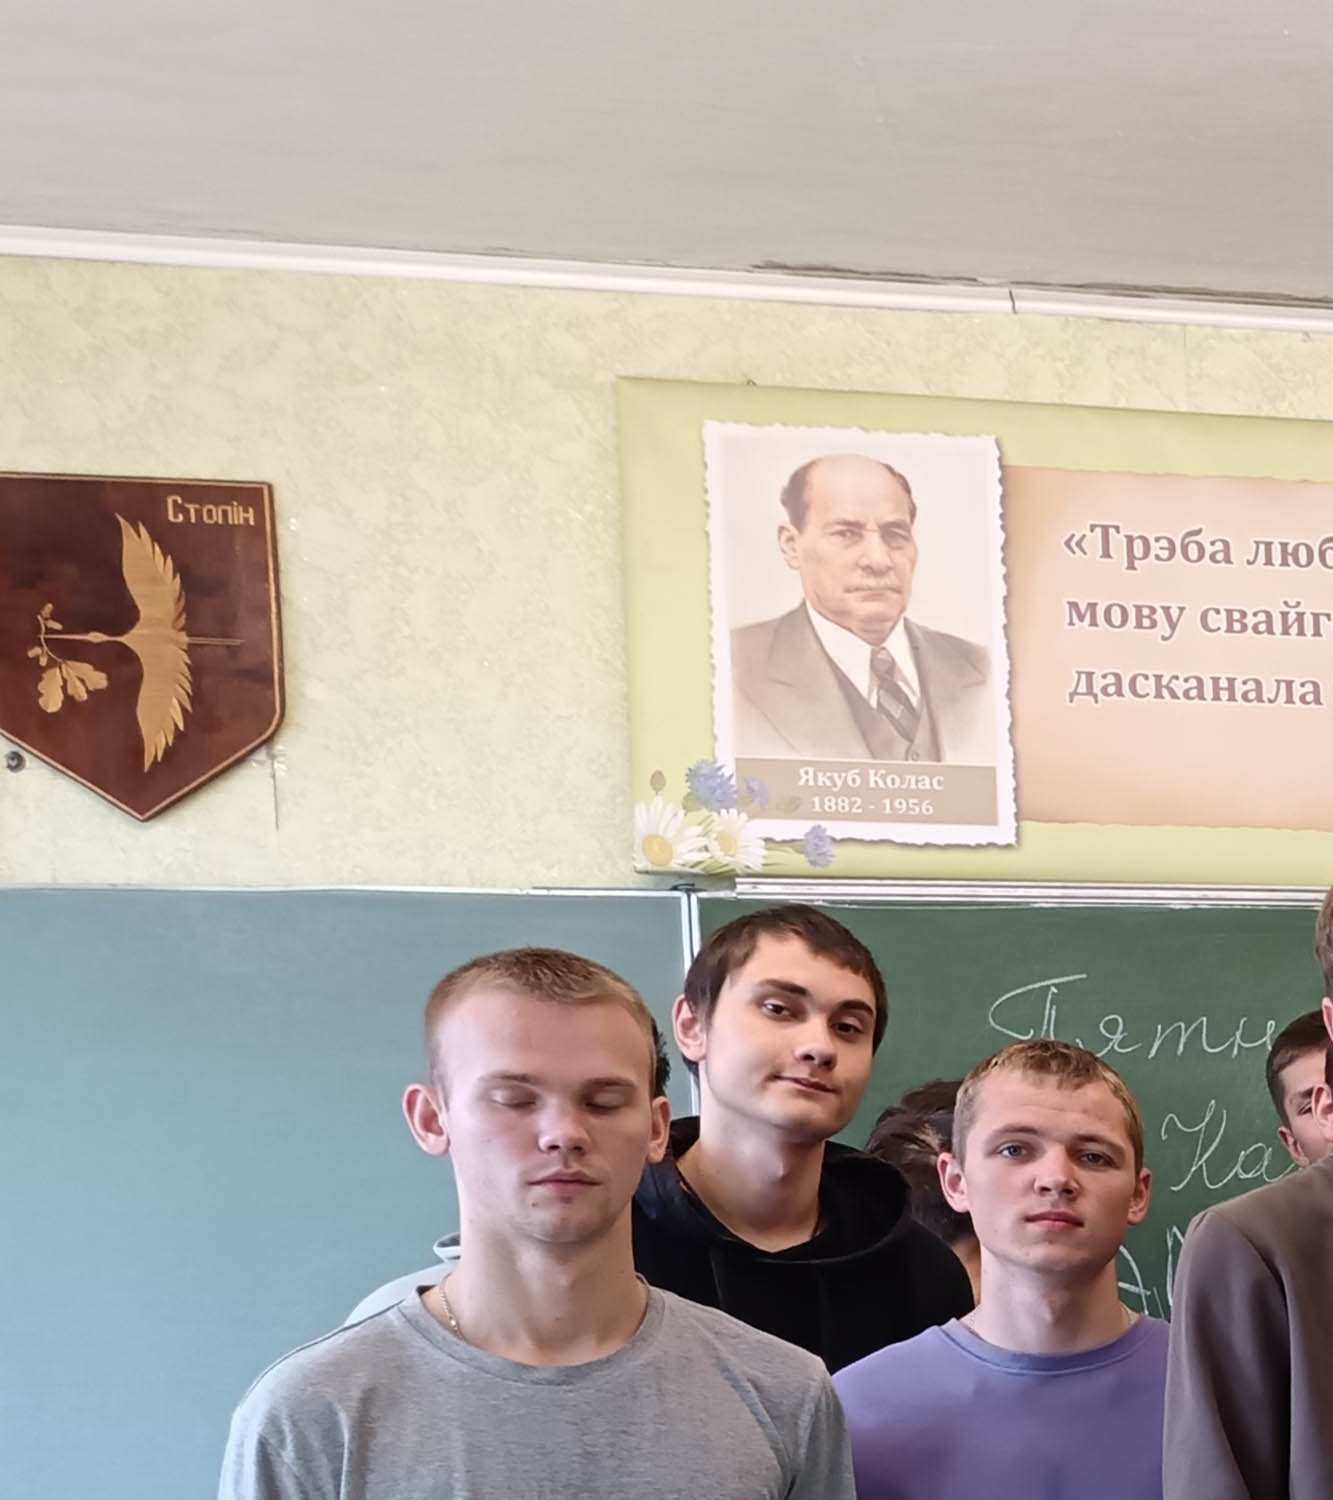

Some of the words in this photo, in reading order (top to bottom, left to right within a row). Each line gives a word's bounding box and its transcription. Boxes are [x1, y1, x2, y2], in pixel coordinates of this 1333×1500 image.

[166, 495, 255, 526] Стопін
[1063, 523, 1234, 571] «Трэба
[1066, 600, 1186, 642] мову
[1068, 670, 1324, 706] дасканала
[799, 766, 862, 792] Якуб
[868, 769, 945, 790] Колас
[812, 795, 863, 814] 1882
[882, 798, 934, 815] 1956
[988, 973, 1278, 1059] Пятн
